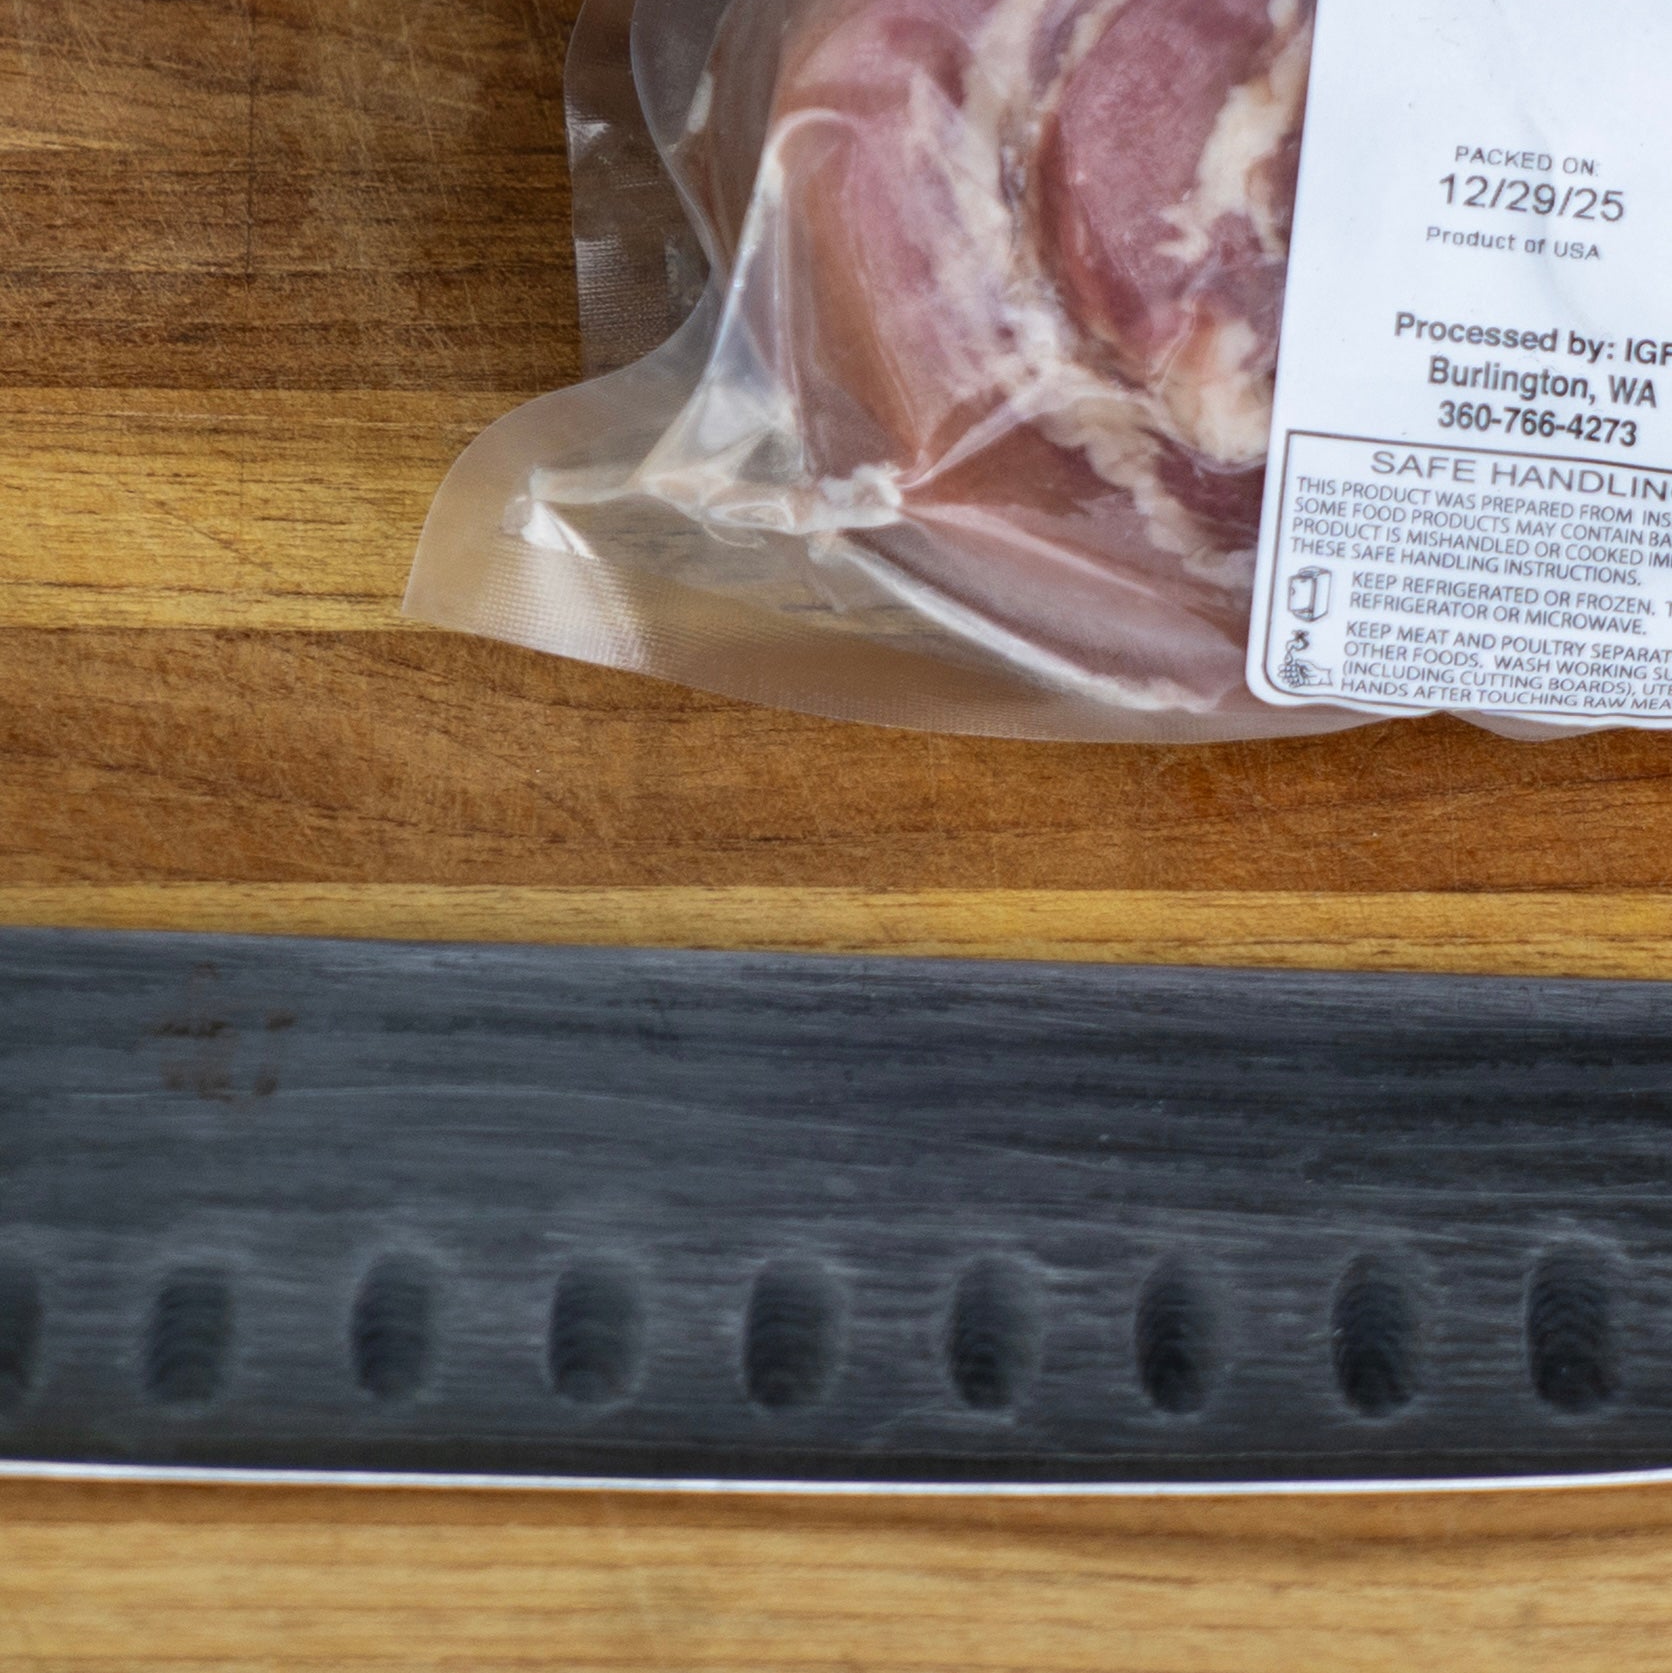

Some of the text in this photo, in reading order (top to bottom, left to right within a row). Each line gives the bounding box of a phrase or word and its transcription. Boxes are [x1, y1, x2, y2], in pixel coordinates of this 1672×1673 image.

[1455, 145, 1553, 172] PACKED
[1439, 173, 1625, 223] 12/29/25
[1425, 225, 1601, 261] Product of USA
[1394, 311, 1558, 353] Processed
[1567, 330, 1615, 364] by:
[1427, 355, 1658, 409] Burlington, WA
[1437, 400, 1638, 448] 360-766-4273
[1370, 450, 1477, 484] SAFE
[1293, 495, 1348, 518] SOME
[1351, 502, 1407, 523] FOOD
[1410, 508, 1511, 534] PRODUCTS
[1514, 518, 1557, 538] MAY
[1560, 522, 1644, 546] CONTAIN
[1295, 476, 1337, 496] THIS
[1341, 480, 1432, 506] PRODUCT
[1435, 490, 1477, 511] WAS
[1480, 494, 1575, 520] PREPARED
[1579, 503, 1633, 525] FROM
[1289, 536, 1642, 588] THESE SAFE HANDLING INSTRUCTIONS.
[1291, 516, 1382, 542] PRODUCT
[1385, 526, 1400, 544] IS
[1405, 528, 1530, 557] MISHANDLED
[1534, 540, 1561, 559] OR
[1564, 543, 1644, 567] COOKED
[1349, 591, 1648, 636] REFRIGERATOR OR MICROWAVE.
[1351, 570, 1398, 591] KEEP
[1401, 576, 1539, 605] REFRIGERATED
[1543, 589, 1571, 609] OR
[1575, 591, 1656, 617] FROZEN.
[1343, 640, 1408, 662] OTHER
[1411, 646, 1484, 669] FOODS.
[1493, 654, 1551, 674] WASH
[1556, 659, 1648, 680] WORKING
[1345, 620, 1392, 639] KEEP
[1396, 625, 1450, 646] MEAT
[1452, 631, 1497, 650] AND
[1500, 634, 1587, 658] POULTRY
[1340, 678, 1409, 697] HANDS
[1413, 684, 1472, 703] AFTER
[1475, 688, 1578, 707] TOUCHING
[1582, 694, 1628, 709] RAW
[1341, 659, 1455, 684] (INCLUDING
[1459, 670, 1543, 691] CUTTING
[1547, 677, 1636, 698] BOARDS),
